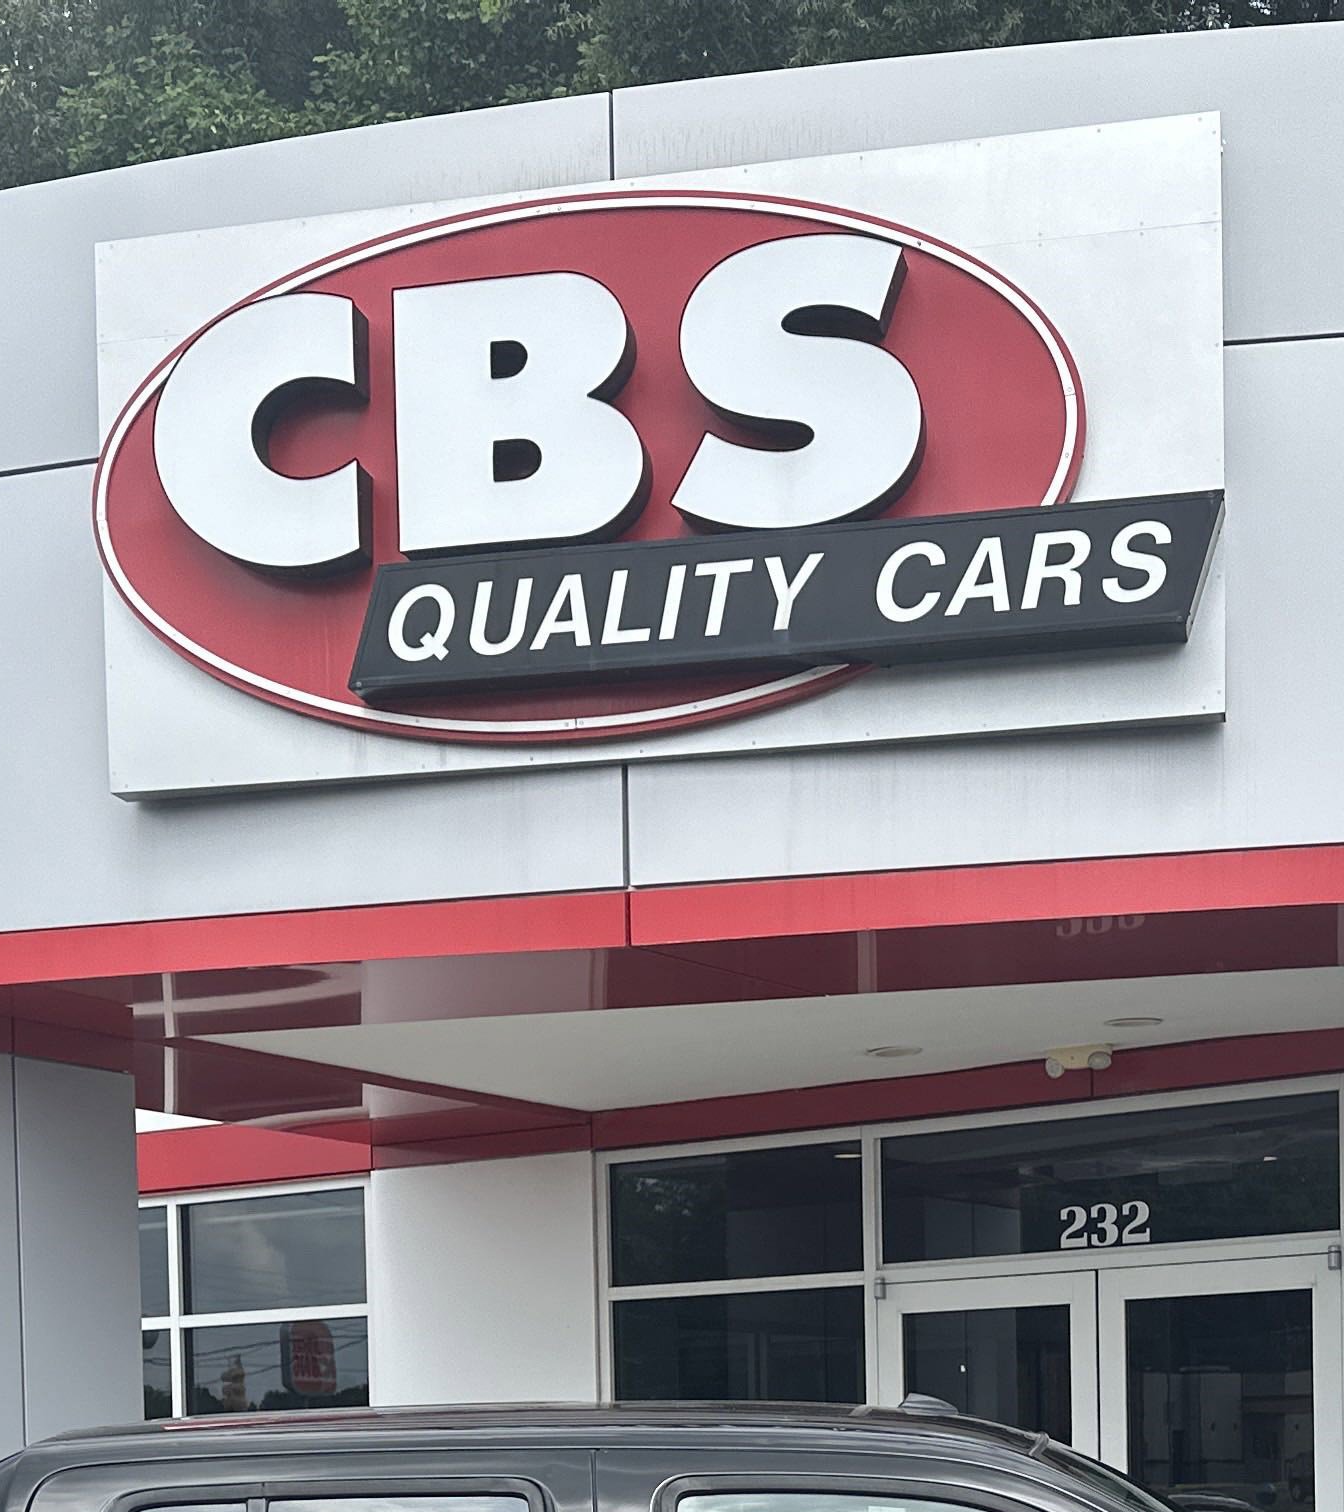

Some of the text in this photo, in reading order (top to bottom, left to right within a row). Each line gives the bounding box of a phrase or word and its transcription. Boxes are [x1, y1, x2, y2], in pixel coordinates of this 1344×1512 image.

[152, 232, 924, 568] CBS
[387, 519, 1173, 662] QUALITY CARS
[1060, 1200, 1151, 1249] 232
